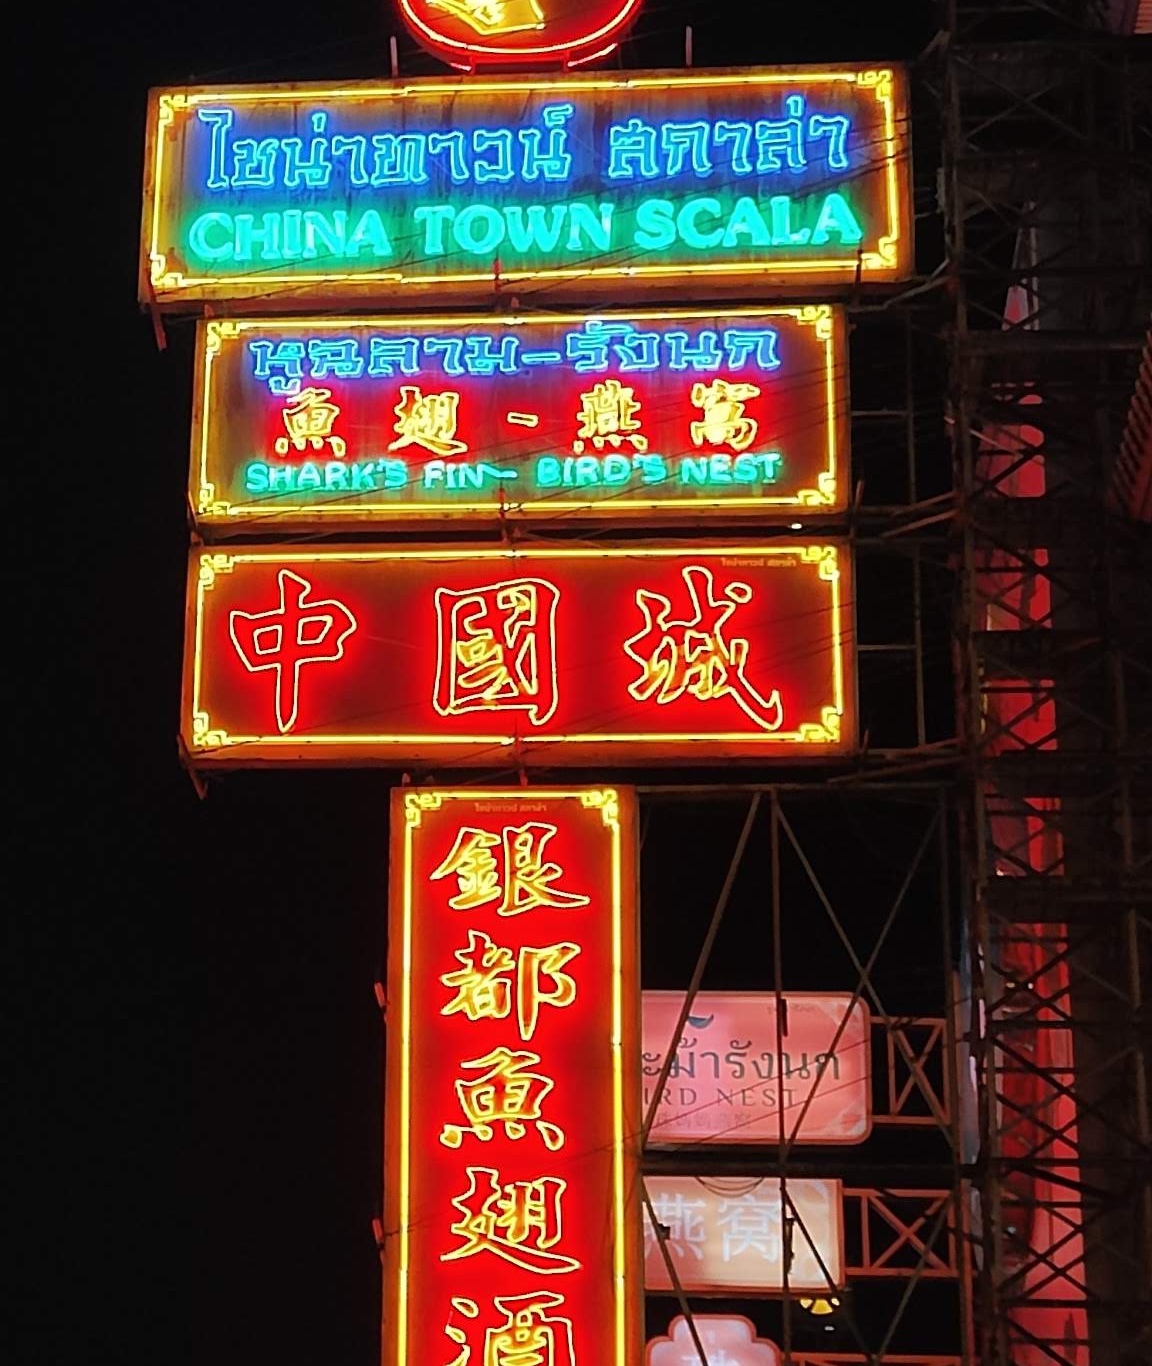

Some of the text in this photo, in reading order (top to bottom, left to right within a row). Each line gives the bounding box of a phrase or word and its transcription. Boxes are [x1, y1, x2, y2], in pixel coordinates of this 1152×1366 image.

[199, 97, 850, 189] ไชน่าทาวน์ สกาล่า
[188, 195, 863, 261] CHINA TOWN SCALA
[246, 459, 408, 491] SHARK'S
[536, 455, 665, 489] BIRD'S
[681, 453, 783, 485] NEST
[717, 1088, 798, 1106] NEST
